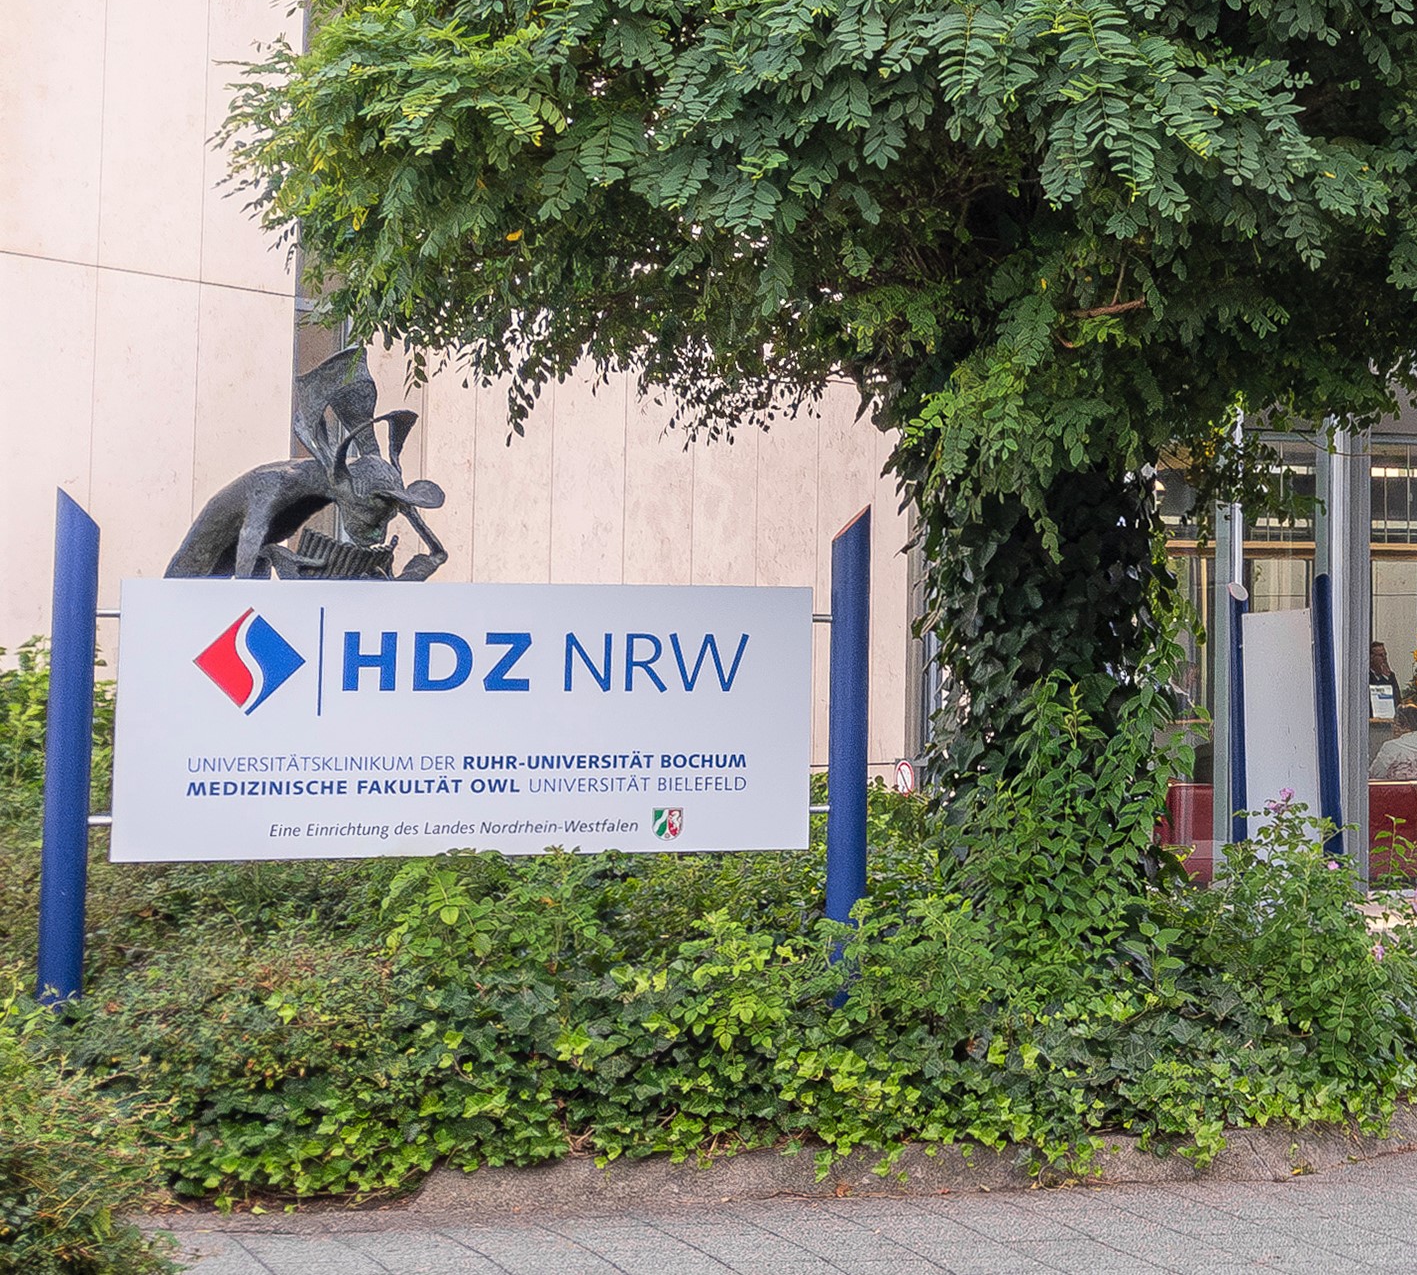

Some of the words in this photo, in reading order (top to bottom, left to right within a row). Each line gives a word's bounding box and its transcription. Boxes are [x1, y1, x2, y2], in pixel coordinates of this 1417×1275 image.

[341, 631, 532, 692] HDZ
[564, 631, 750, 693] NRW
[187, 752, 416, 774] UNIVERSITÄTSKLINIKUM
[420, 754, 456, 771] DER
[463, 751, 654, 770] RUHR-UNIVERSITÄT
[660, 753, 747, 769] BOCHUM
[186, 780, 348, 797] MEDIZINISCHE
[357, 776, 463, 795] FAKULTÄT
[470, 778, 521, 794] OWL
[529, 774, 651, 793] UNIVERSITÄT
[657, 776, 748, 792] BIELEFELD
[269, 823, 301, 838] Eine
[306, 822, 390, 840] Einrichtung
[394, 821, 419, 836] des
[424, 820, 475, 835] Landes
[479, 818, 639, 834] Nordrhein-Westfalen
